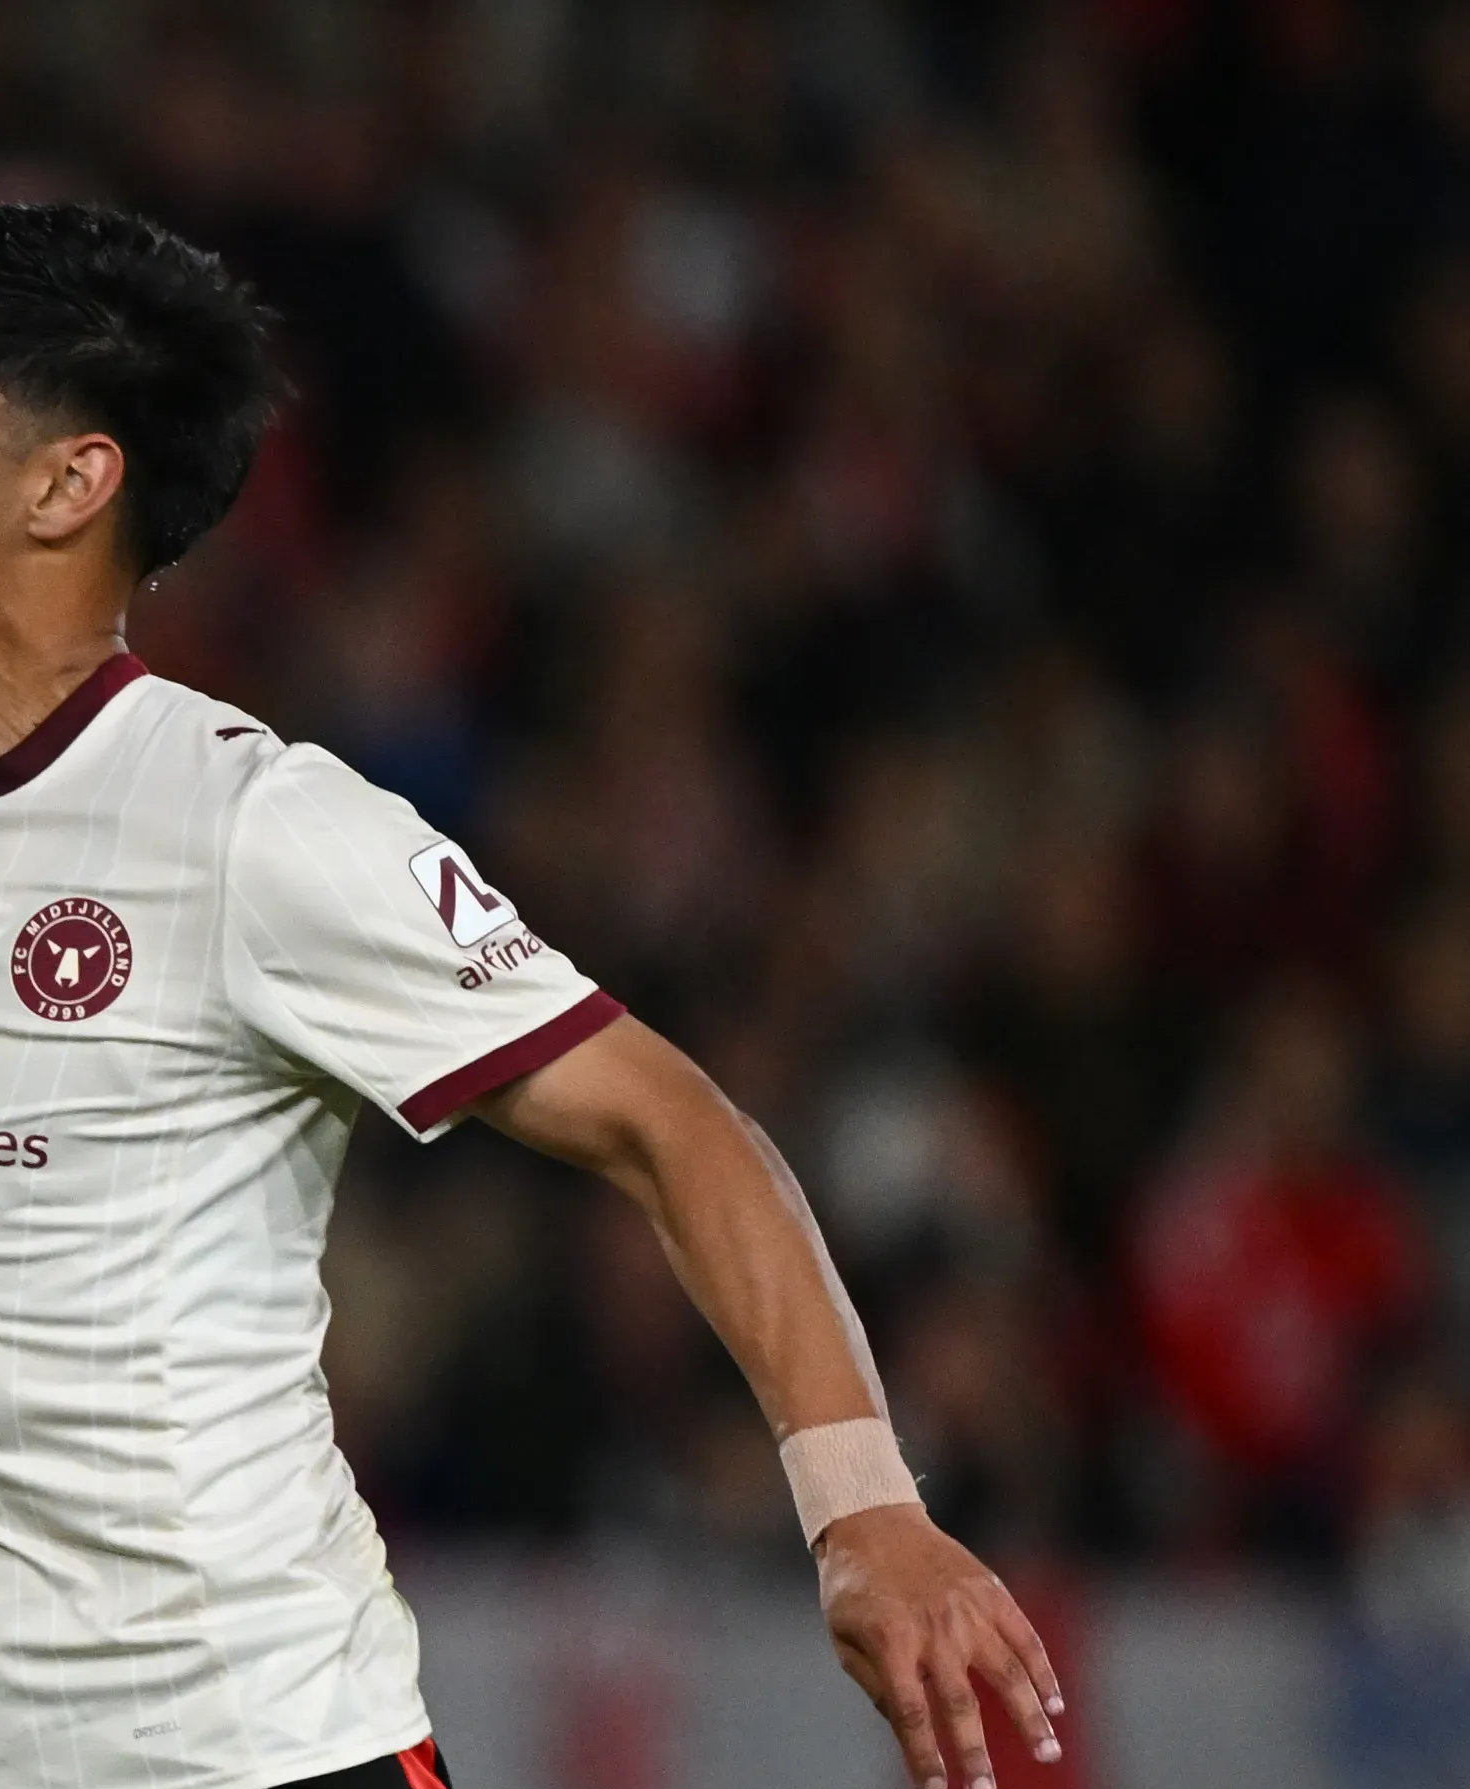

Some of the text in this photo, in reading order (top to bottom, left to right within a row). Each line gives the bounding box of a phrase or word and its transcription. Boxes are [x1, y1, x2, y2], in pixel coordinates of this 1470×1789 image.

[13, 900, 131, 988] FC MIDTJYLLAND
[37, 1001, 86, 1020] 1999
